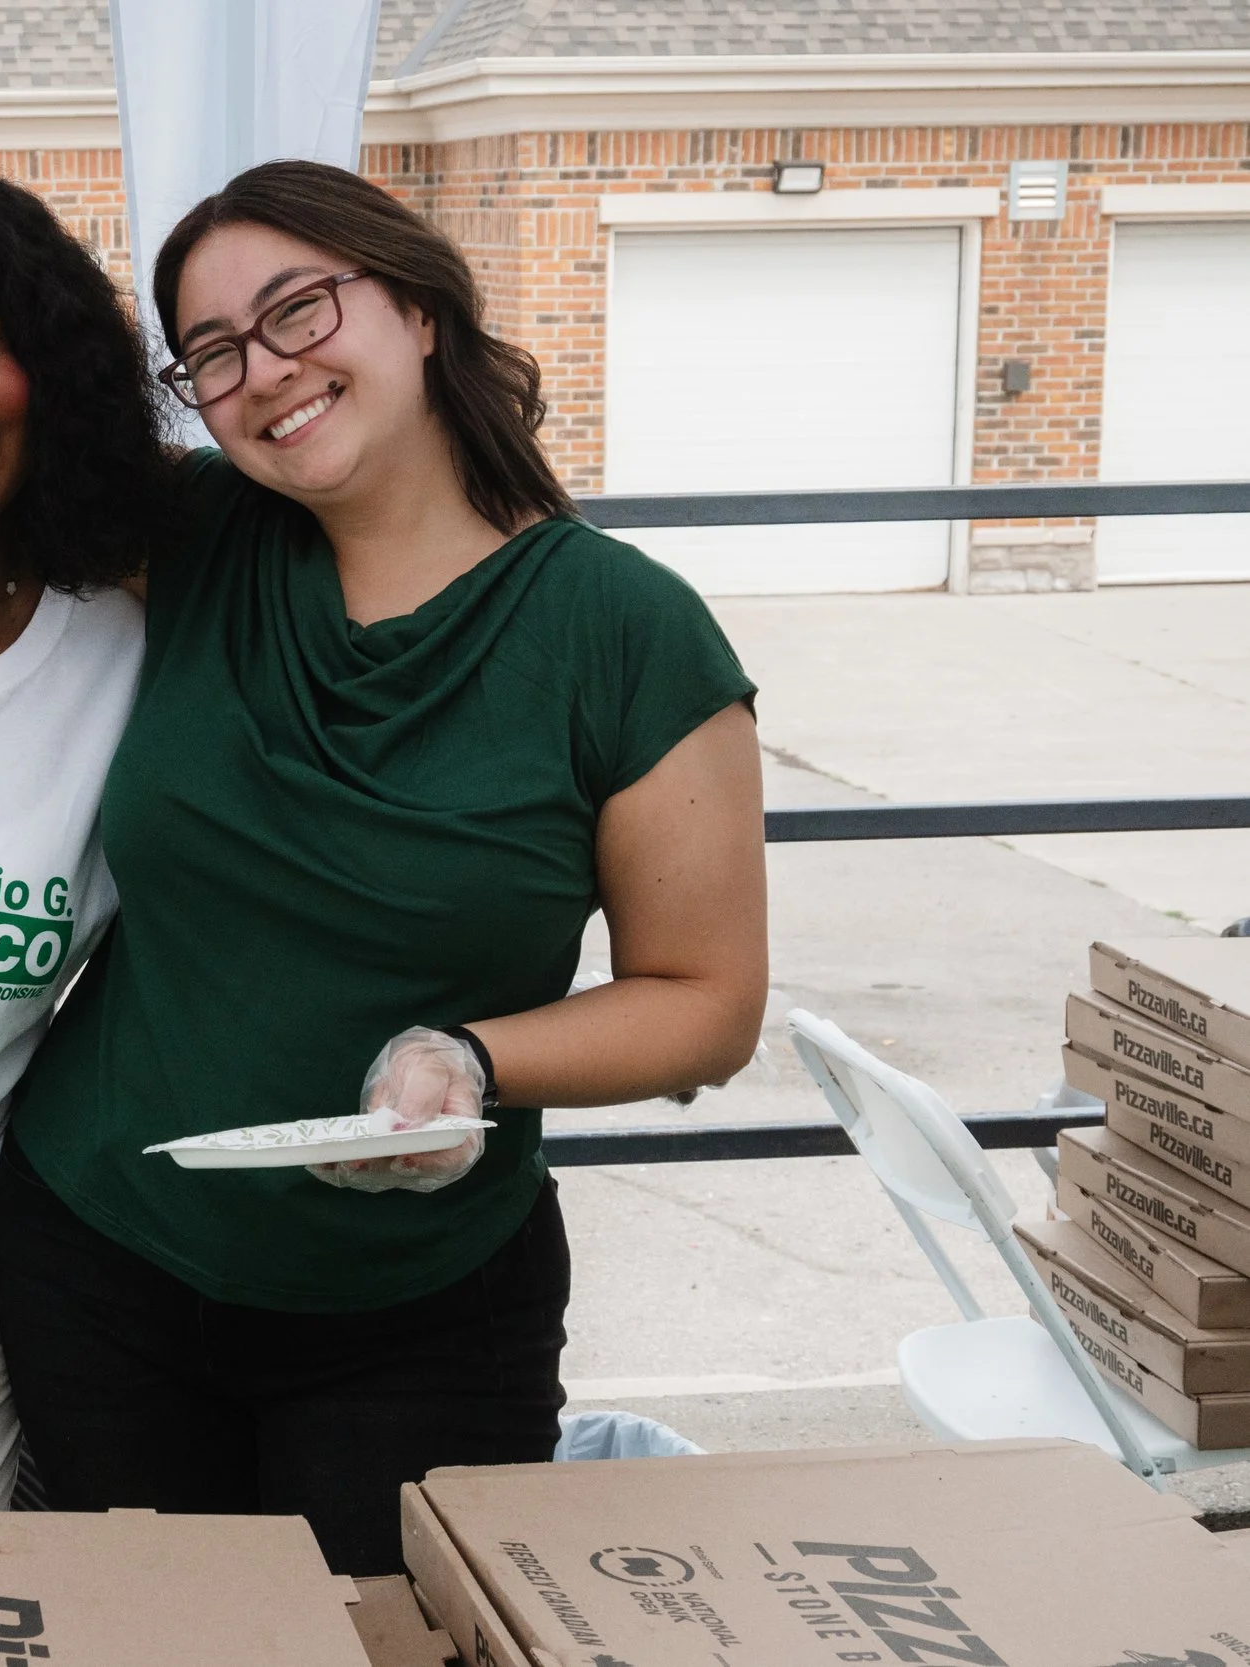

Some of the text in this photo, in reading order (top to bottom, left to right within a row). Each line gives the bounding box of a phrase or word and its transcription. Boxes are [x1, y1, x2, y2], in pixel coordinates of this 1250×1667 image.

[43, 876, 73, 918] G.
[1128, 979, 1207, 1038] Pizzaville.ca
[1113, 1029, 1204, 1091] Pizzaville.ca
[1115, 1079, 1214, 1141] Pizzaville.ca
[1150, 1122, 1233, 1189] Pizzaville.ca
[1106, 1172, 1198, 1241] Pizzaville.ca
[1091, 1209, 1154, 1281] Pizzaville.ca
[1051, 1271, 1129, 1346] Pizzaville.ca
[498, 1540, 607, 1647] FIERCELY CANADIAN
[629, 1590, 663, 1616] OPEN
[651, 1591, 698, 1624] BANK
[678, 1591, 743, 1649] NATIONAL
[763, 1571, 863, 1640] STONE
